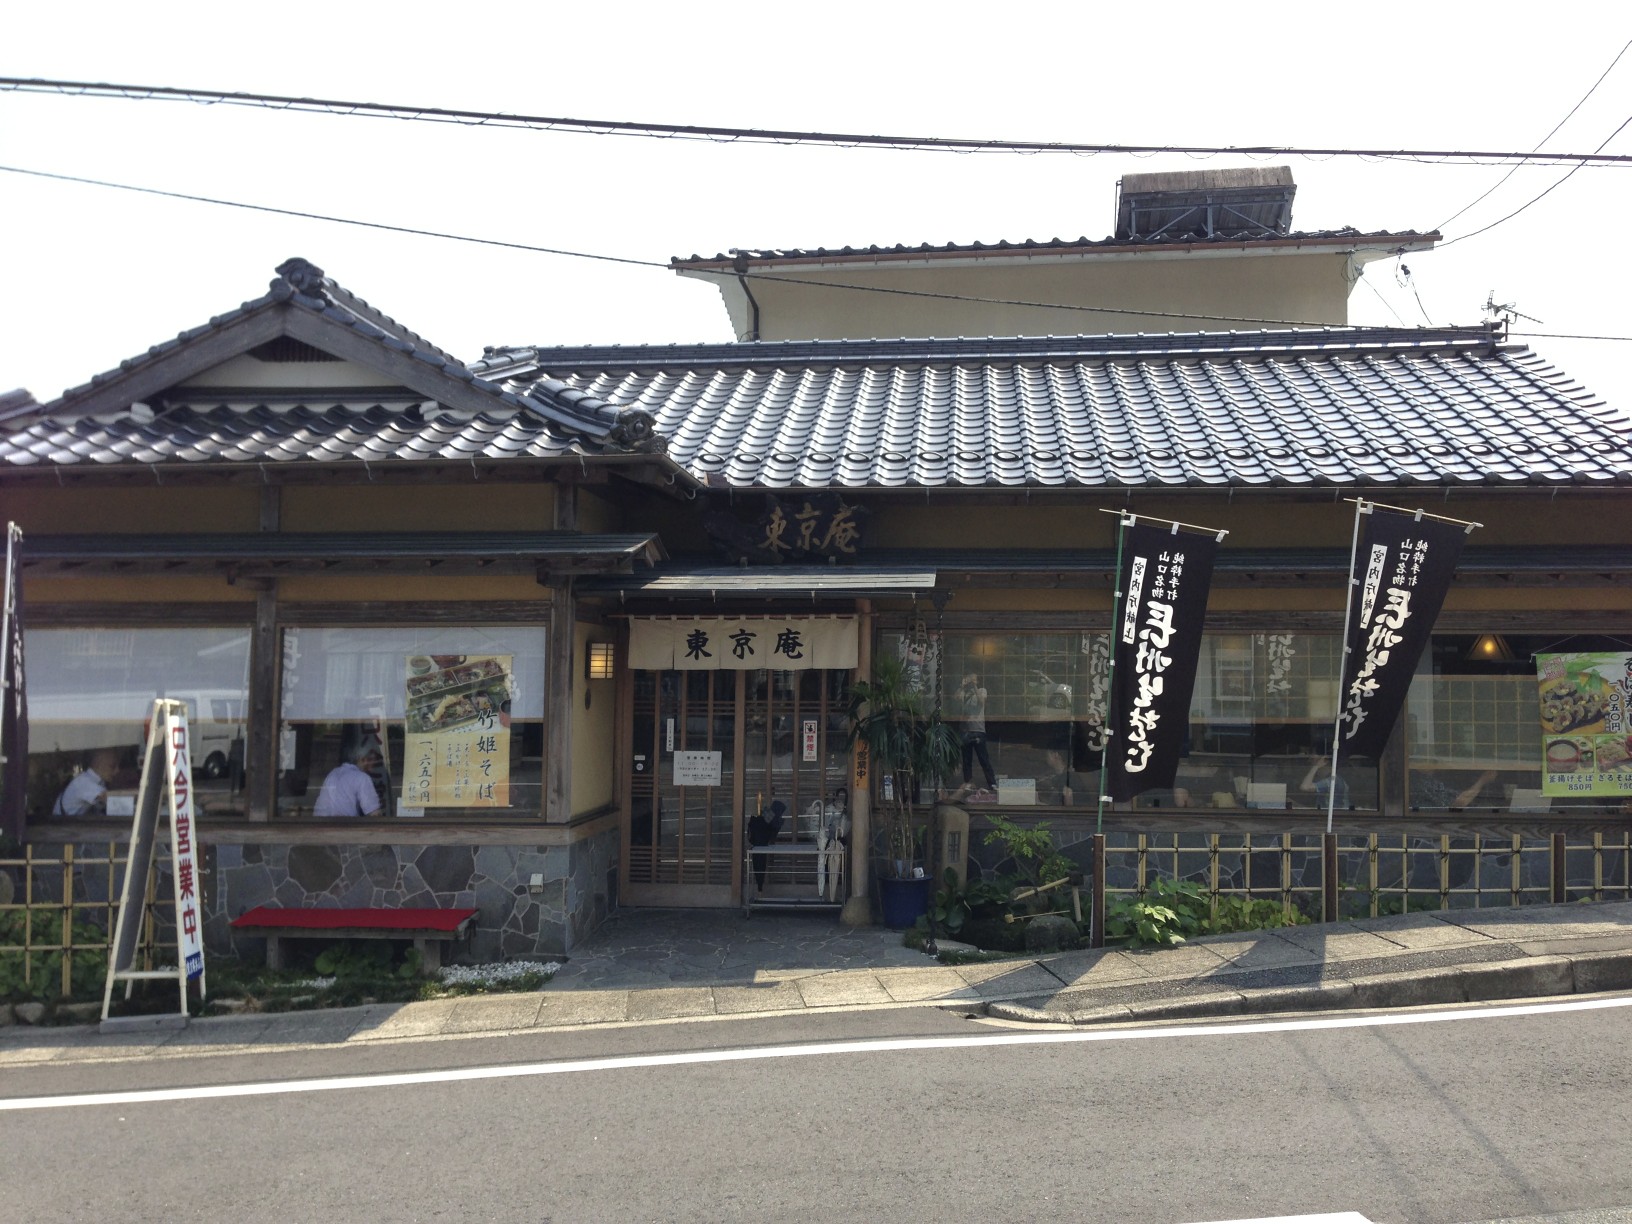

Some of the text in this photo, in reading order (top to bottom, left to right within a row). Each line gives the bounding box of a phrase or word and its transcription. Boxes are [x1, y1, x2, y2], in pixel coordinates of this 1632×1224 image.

[757, 502, 860, 553] 東京庵
[684, 628, 804, 660] 東京庵
[476, 709, 498, 800] 竹姫そば
[1568, 783, 1592, 791] 850円
[172, 727, 197, 944] 只今営業中
